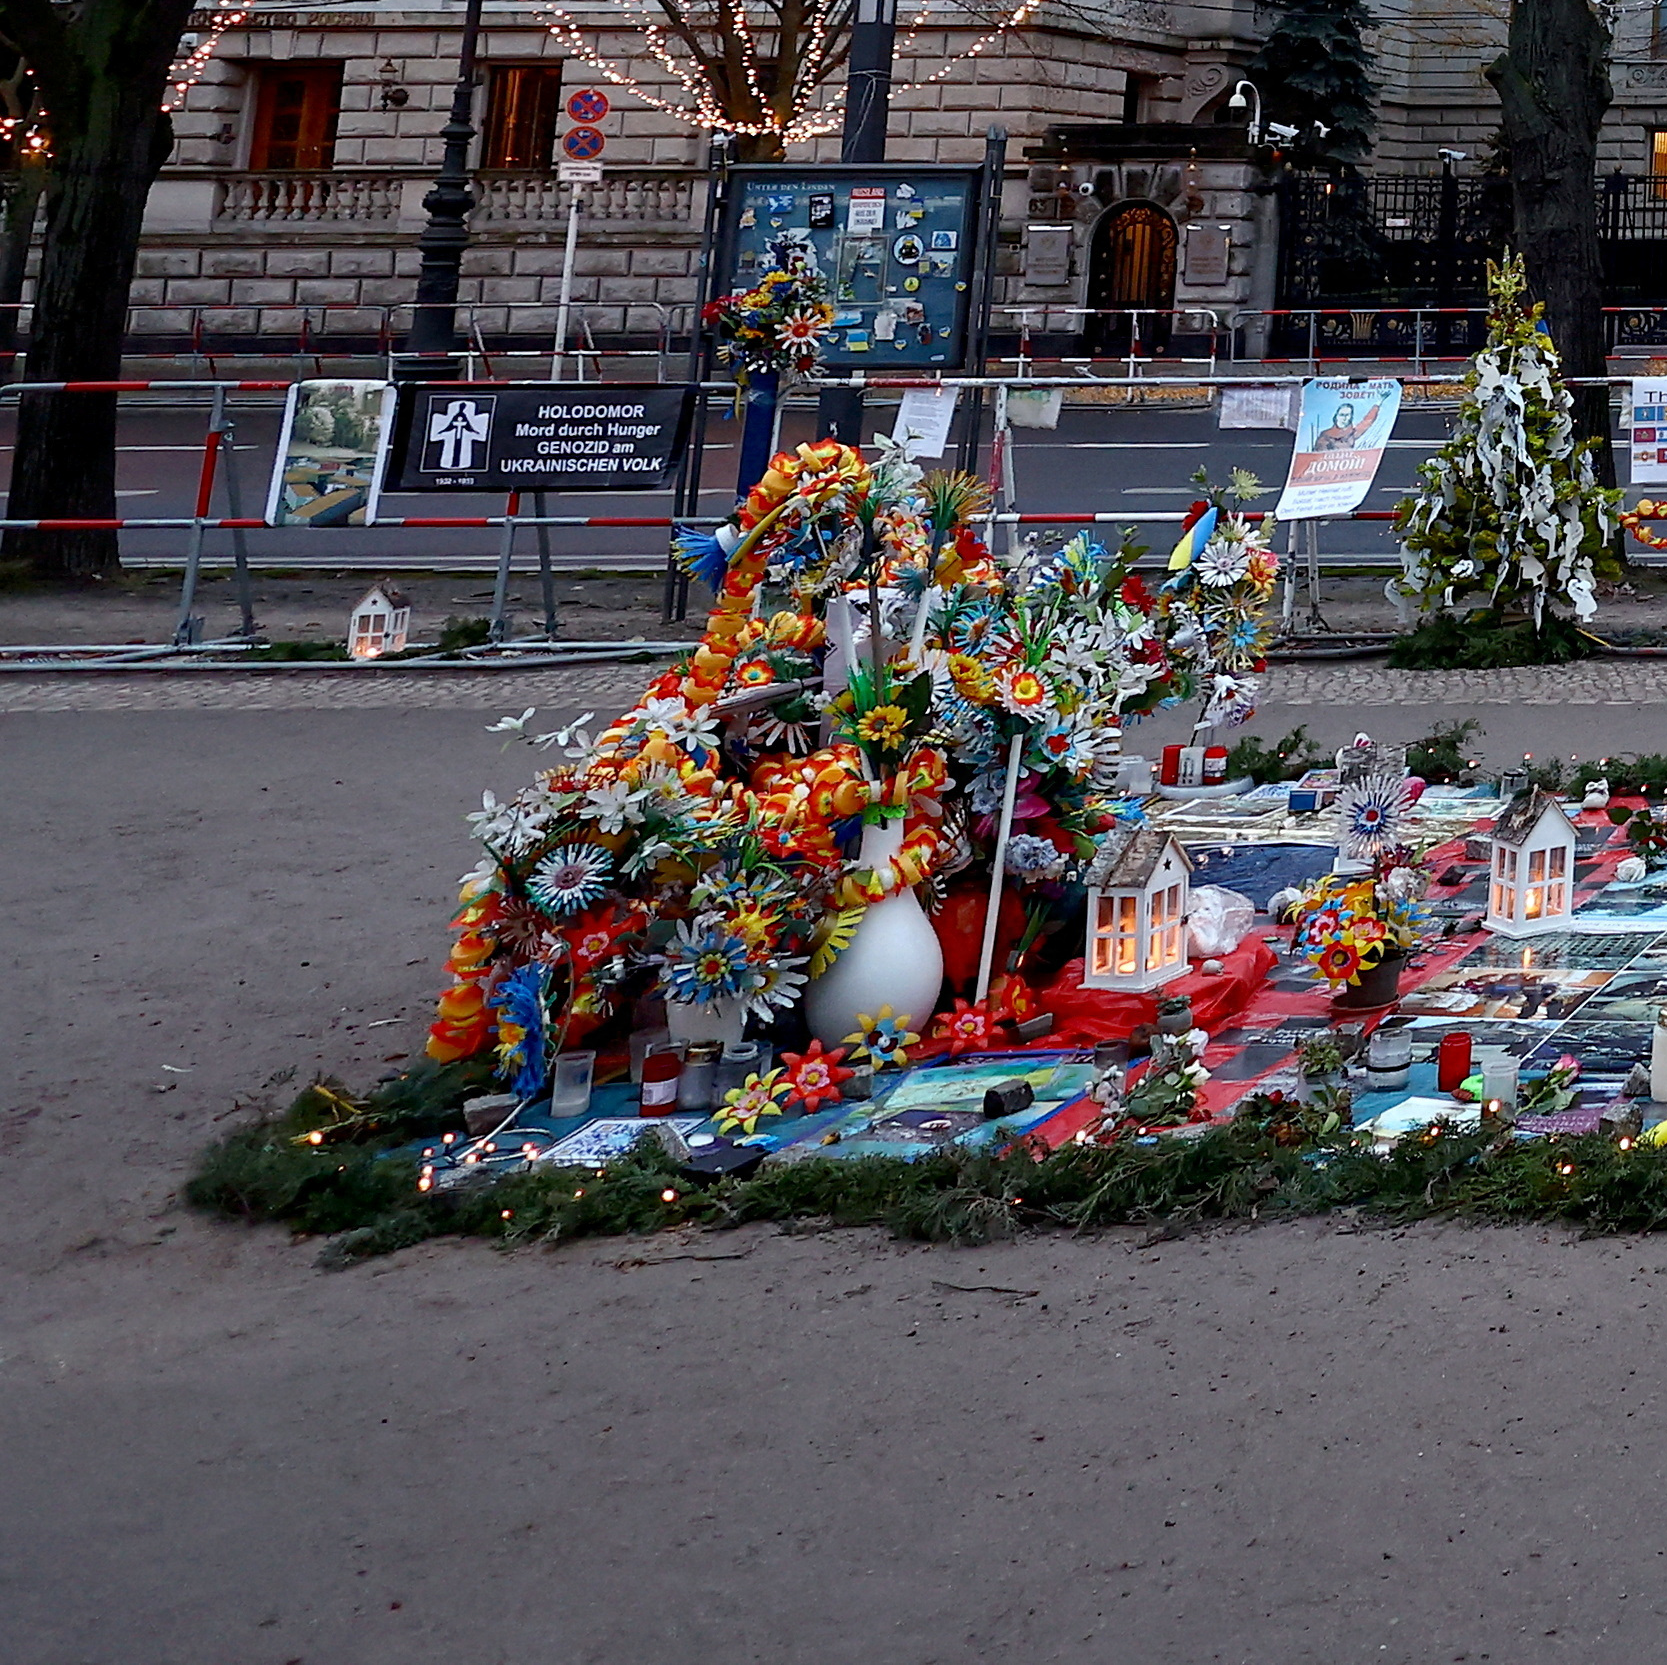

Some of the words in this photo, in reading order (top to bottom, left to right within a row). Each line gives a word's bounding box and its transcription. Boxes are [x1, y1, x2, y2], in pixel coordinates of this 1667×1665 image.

[1369, 381, 1394, 390] МАТЬ
[537, 405, 645, 420] HOLODOMOR
[515, 423, 553, 436] Mord
[558, 422, 604, 436] durch
[607, 422, 661, 439] Hunger
[537, 440, 609, 455] GENOZID
[612, 442, 634, 454] am
[500, 458, 618, 473] UKRAINISCHEN
[621, 456, 663, 472] VOLK
[1304, 455, 1366, 475] ДОМОЙ!
